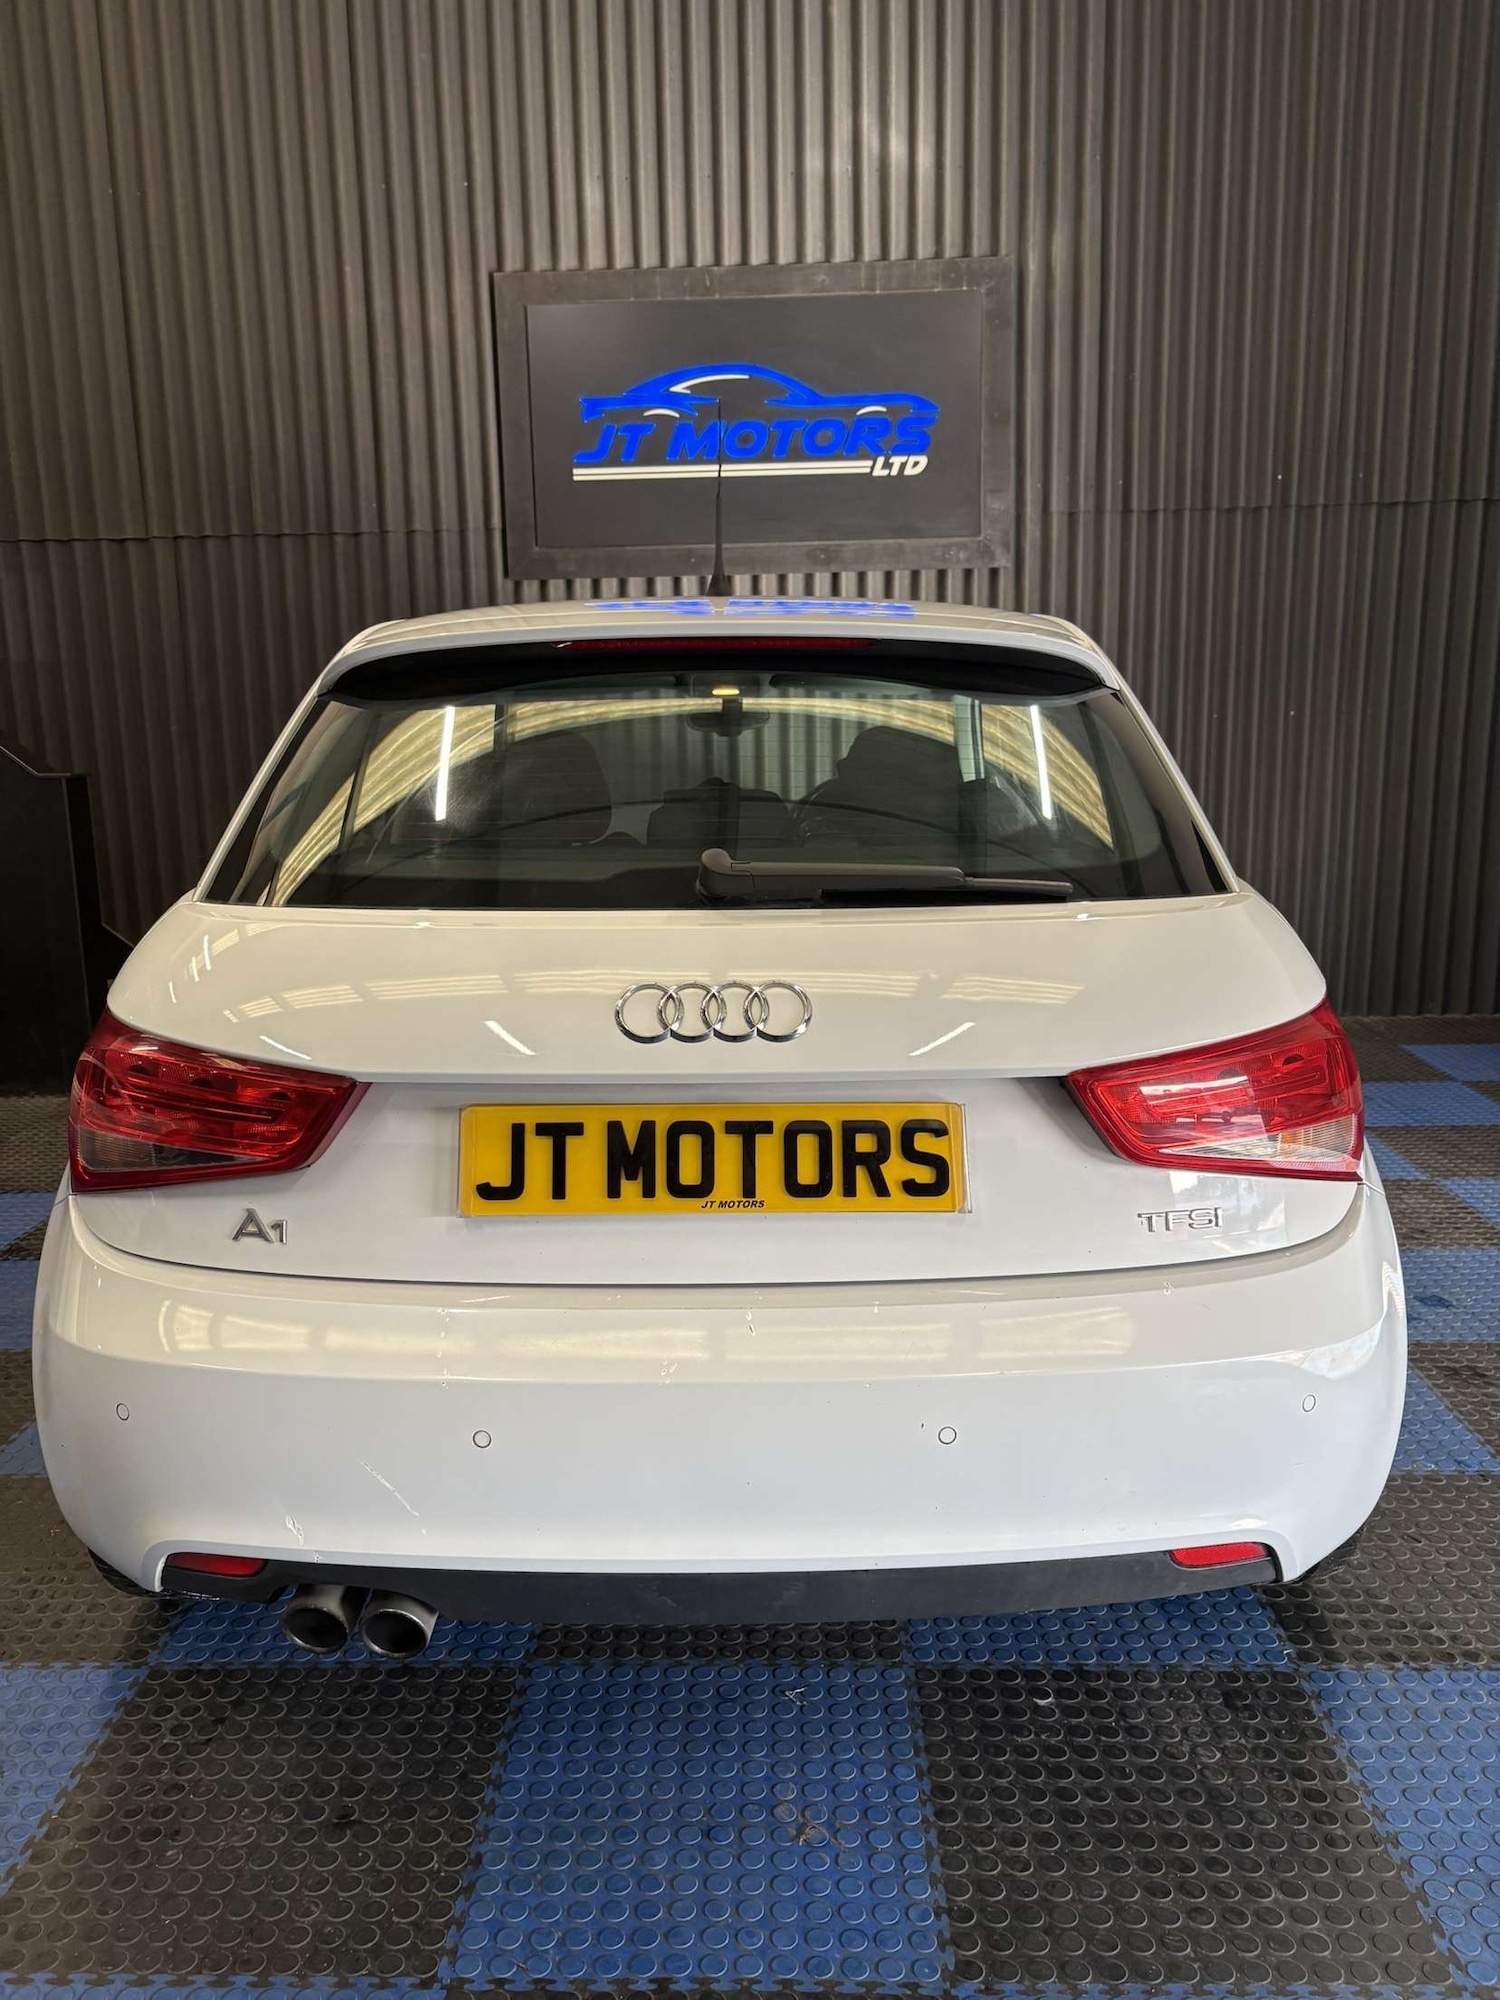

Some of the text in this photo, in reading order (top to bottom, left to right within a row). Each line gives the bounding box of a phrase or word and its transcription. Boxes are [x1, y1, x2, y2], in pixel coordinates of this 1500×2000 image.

[573, 416, 938, 463] JT MOTORS
[871, 455, 928, 477] LTD
[476, 1119, 950, 1200] JT MOTORS
[701, 1200, 765, 1209] JT MOTORS
[1137, 1207, 1223, 1233] TFSI
[232, 1208, 288, 1245] A1
